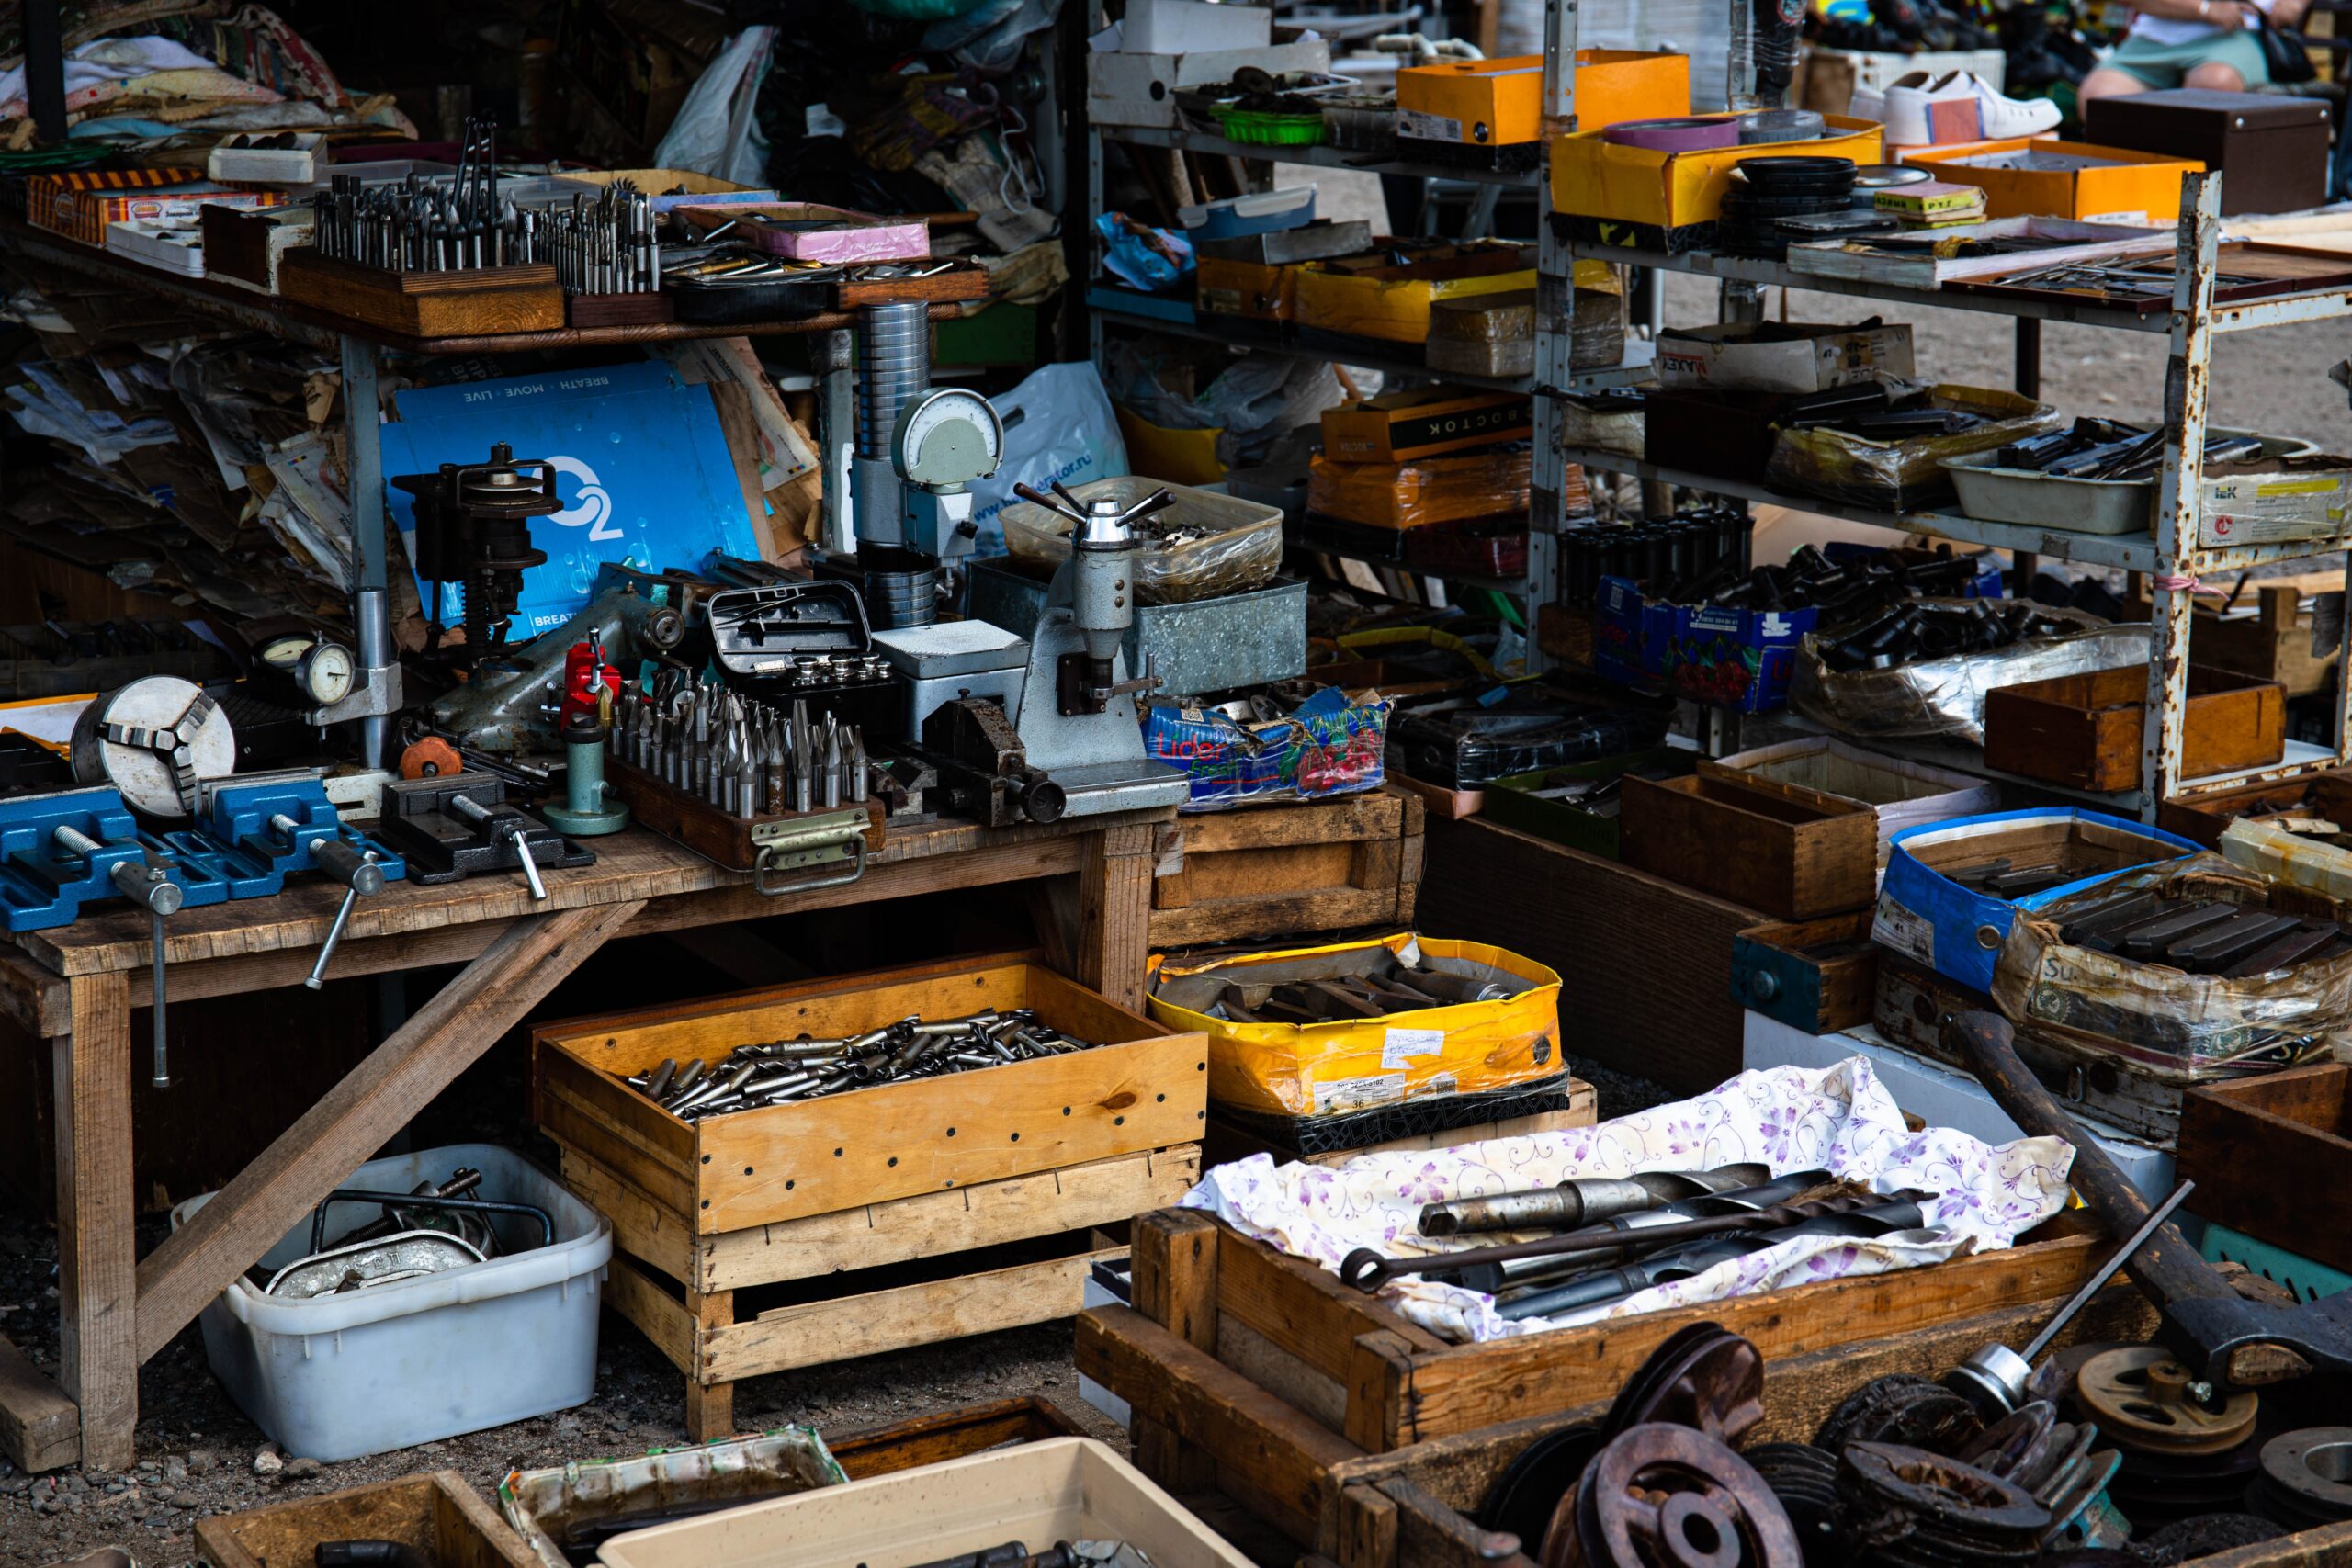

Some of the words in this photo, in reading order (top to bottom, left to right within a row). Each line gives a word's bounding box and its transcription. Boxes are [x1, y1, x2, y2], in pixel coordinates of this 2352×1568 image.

[504, 383, 545, 397] MOVE
[560, 376, 610, 390] BREATH
[463, 390, 492, 403] LIVE
[1429, 408, 1519, 436] ВОСТОК
[534, 612, 579, 627] BREAT
[1157, 731, 1228, 762] Lider
[1351, 1100, 1364, 1110] 36
